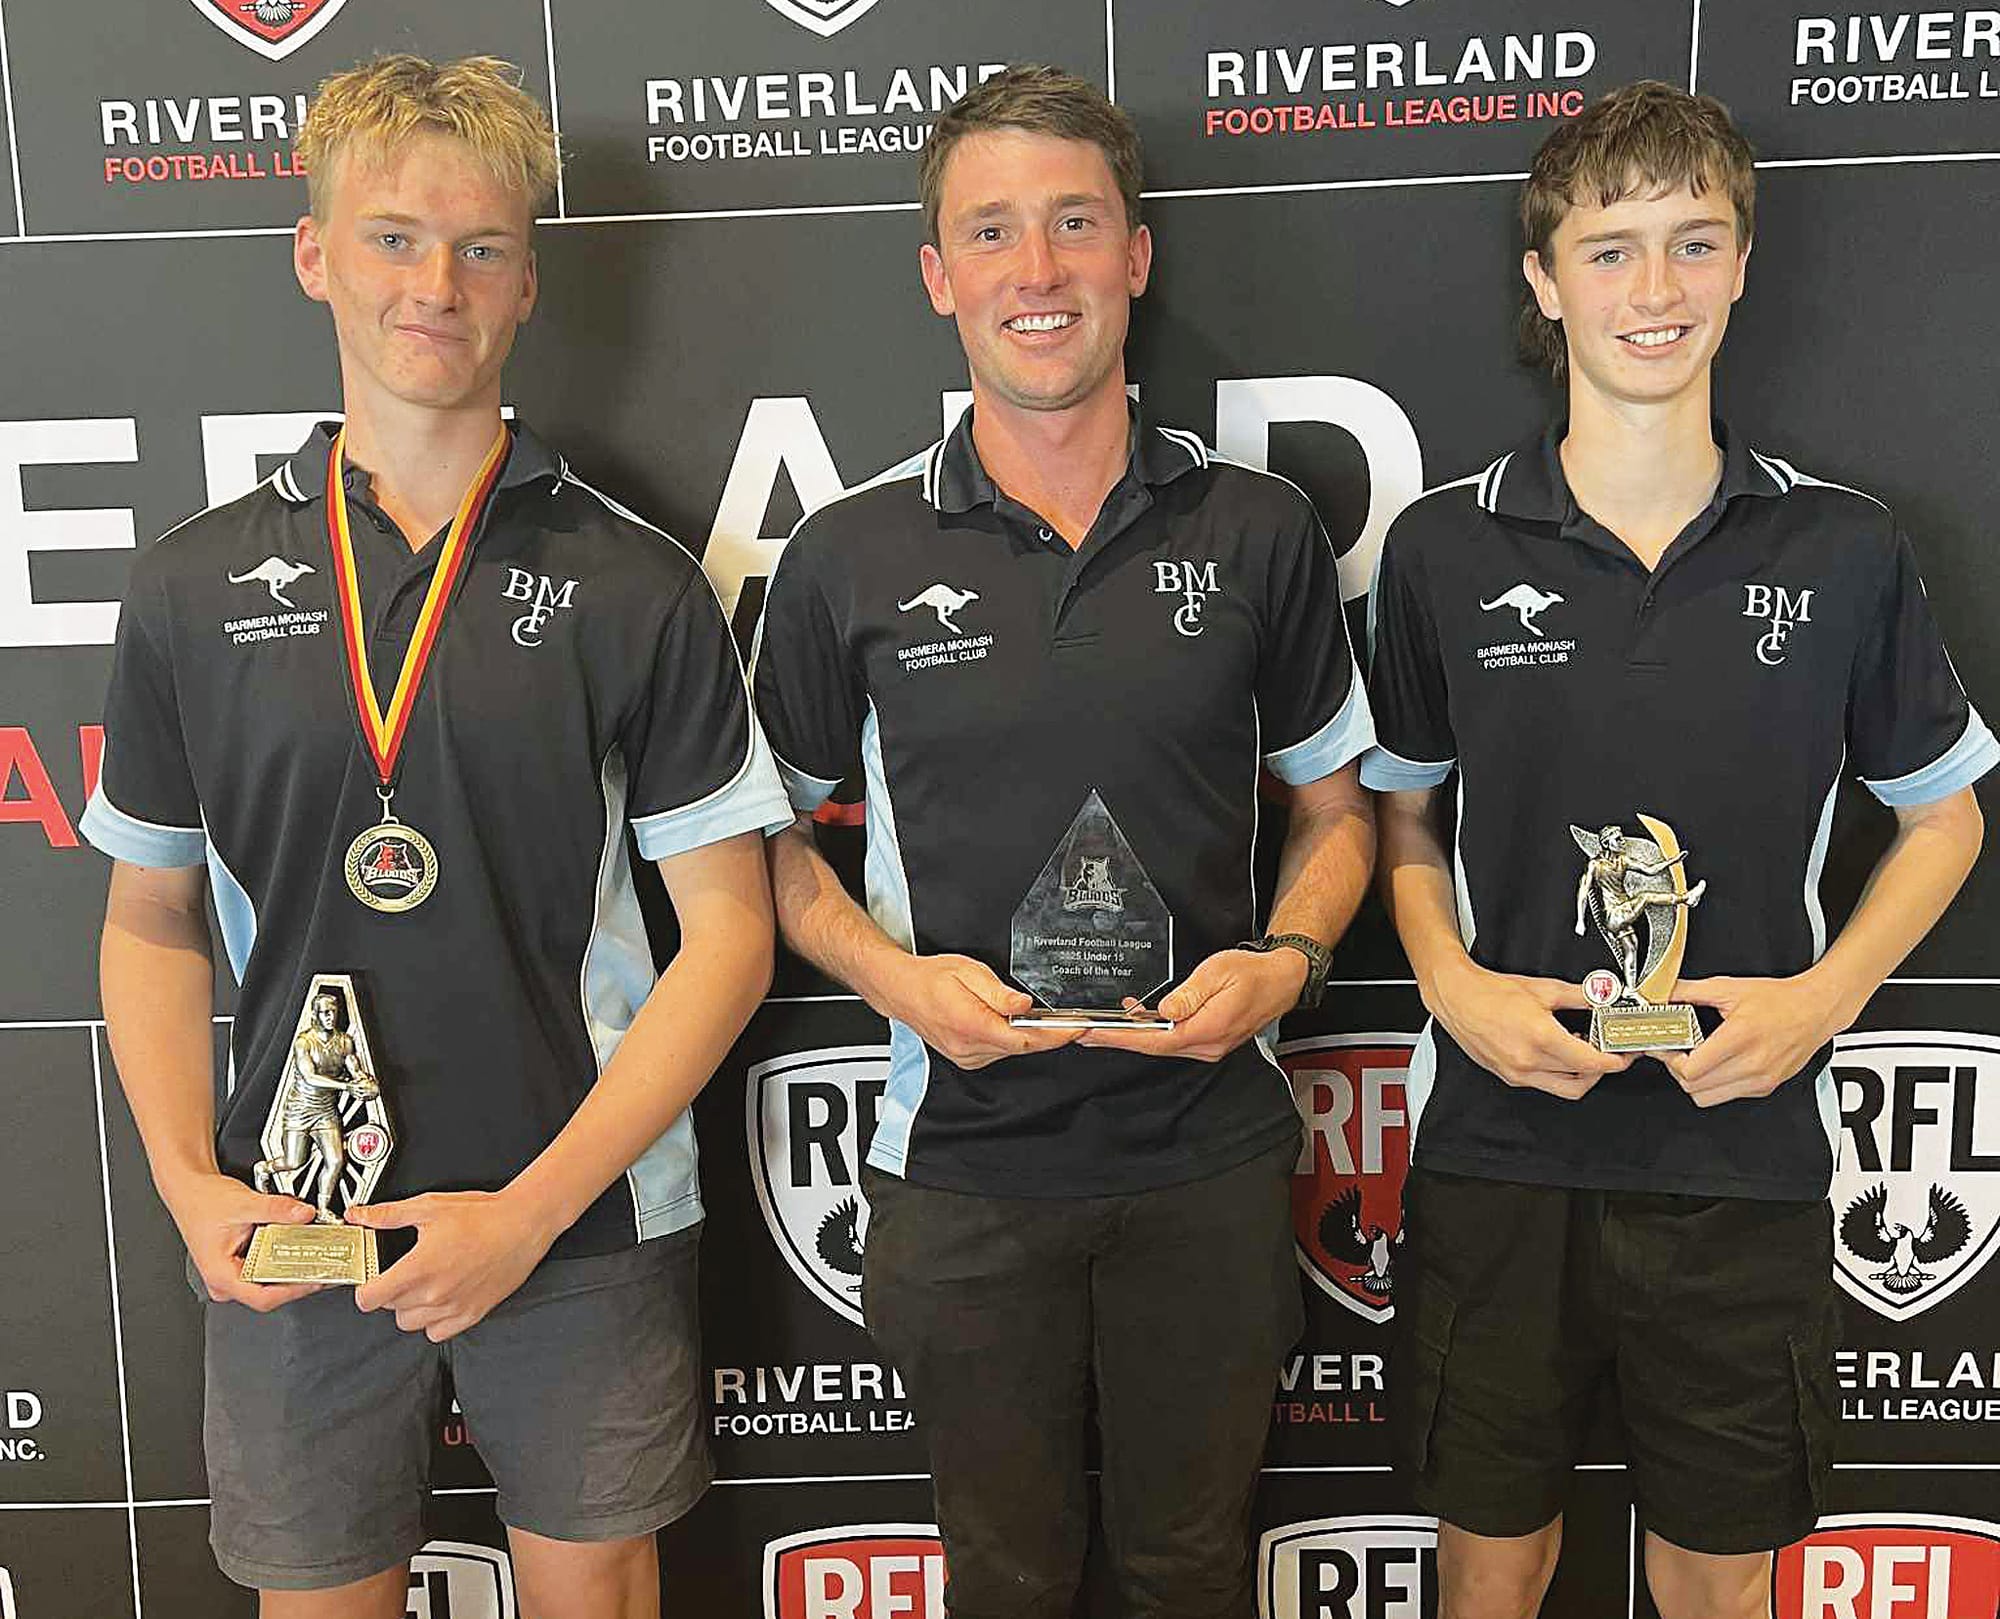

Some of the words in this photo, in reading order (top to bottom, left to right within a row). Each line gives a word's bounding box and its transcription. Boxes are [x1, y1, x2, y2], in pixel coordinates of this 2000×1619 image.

[1795, 10, 2000, 66] RIVER
[1206, 31, 1597, 98] RIVERLAND
[1790, 72, 1970, 105] FOOTBALL
[1205, 102, 1376, 137] FOOTBALL
[1385, 95, 1517, 126] LEAGUE
[1527, 90, 1585, 119] INC
[647, 131, 812, 162] FOOTBALL
[820, 125, 935, 156] LEAGU
[104, 152, 267, 183] FOOTBALL
[223, 615, 277, 633] BARMERA
[277, 610, 328, 625] MONASH
[232, 627, 288, 645] FOOTBALL
[289, 623, 320, 636] CLUB
[897, 641, 946, 661] BARMERA
[946, 634, 993, 651] MONASH
[905, 652, 958, 672] FOOTBALL
[958, 647, 988, 662] CLUB
[1476, 643, 1527, 659] BARMERA
[1527, 639, 1576, 654] MONASH
[1483, 654, 1537, 670] FOOTBALL
[1538, 651, 1569, 664] CLUB
[1033, 935, 1077, 947] Riverland
[1078, 937, 1117, 948] Football
[1118, 939, 1153, 950] League
[1083, 951, 1112, 962] Under
[1051, 964, 1081, 976] Coach
[1083, 965, 1093, 976] of
[1094, 965, 1110, 976] the
[1111, 966, 1133, 977] Year
[1829, 1065, 2000, 1172] RFL
[1835, 1350, 2000, 1389] ERLA
[1883, 1398, 2000, 1421] LEAGUE
[714, 1411, 862, 1436] FOOTBALL
